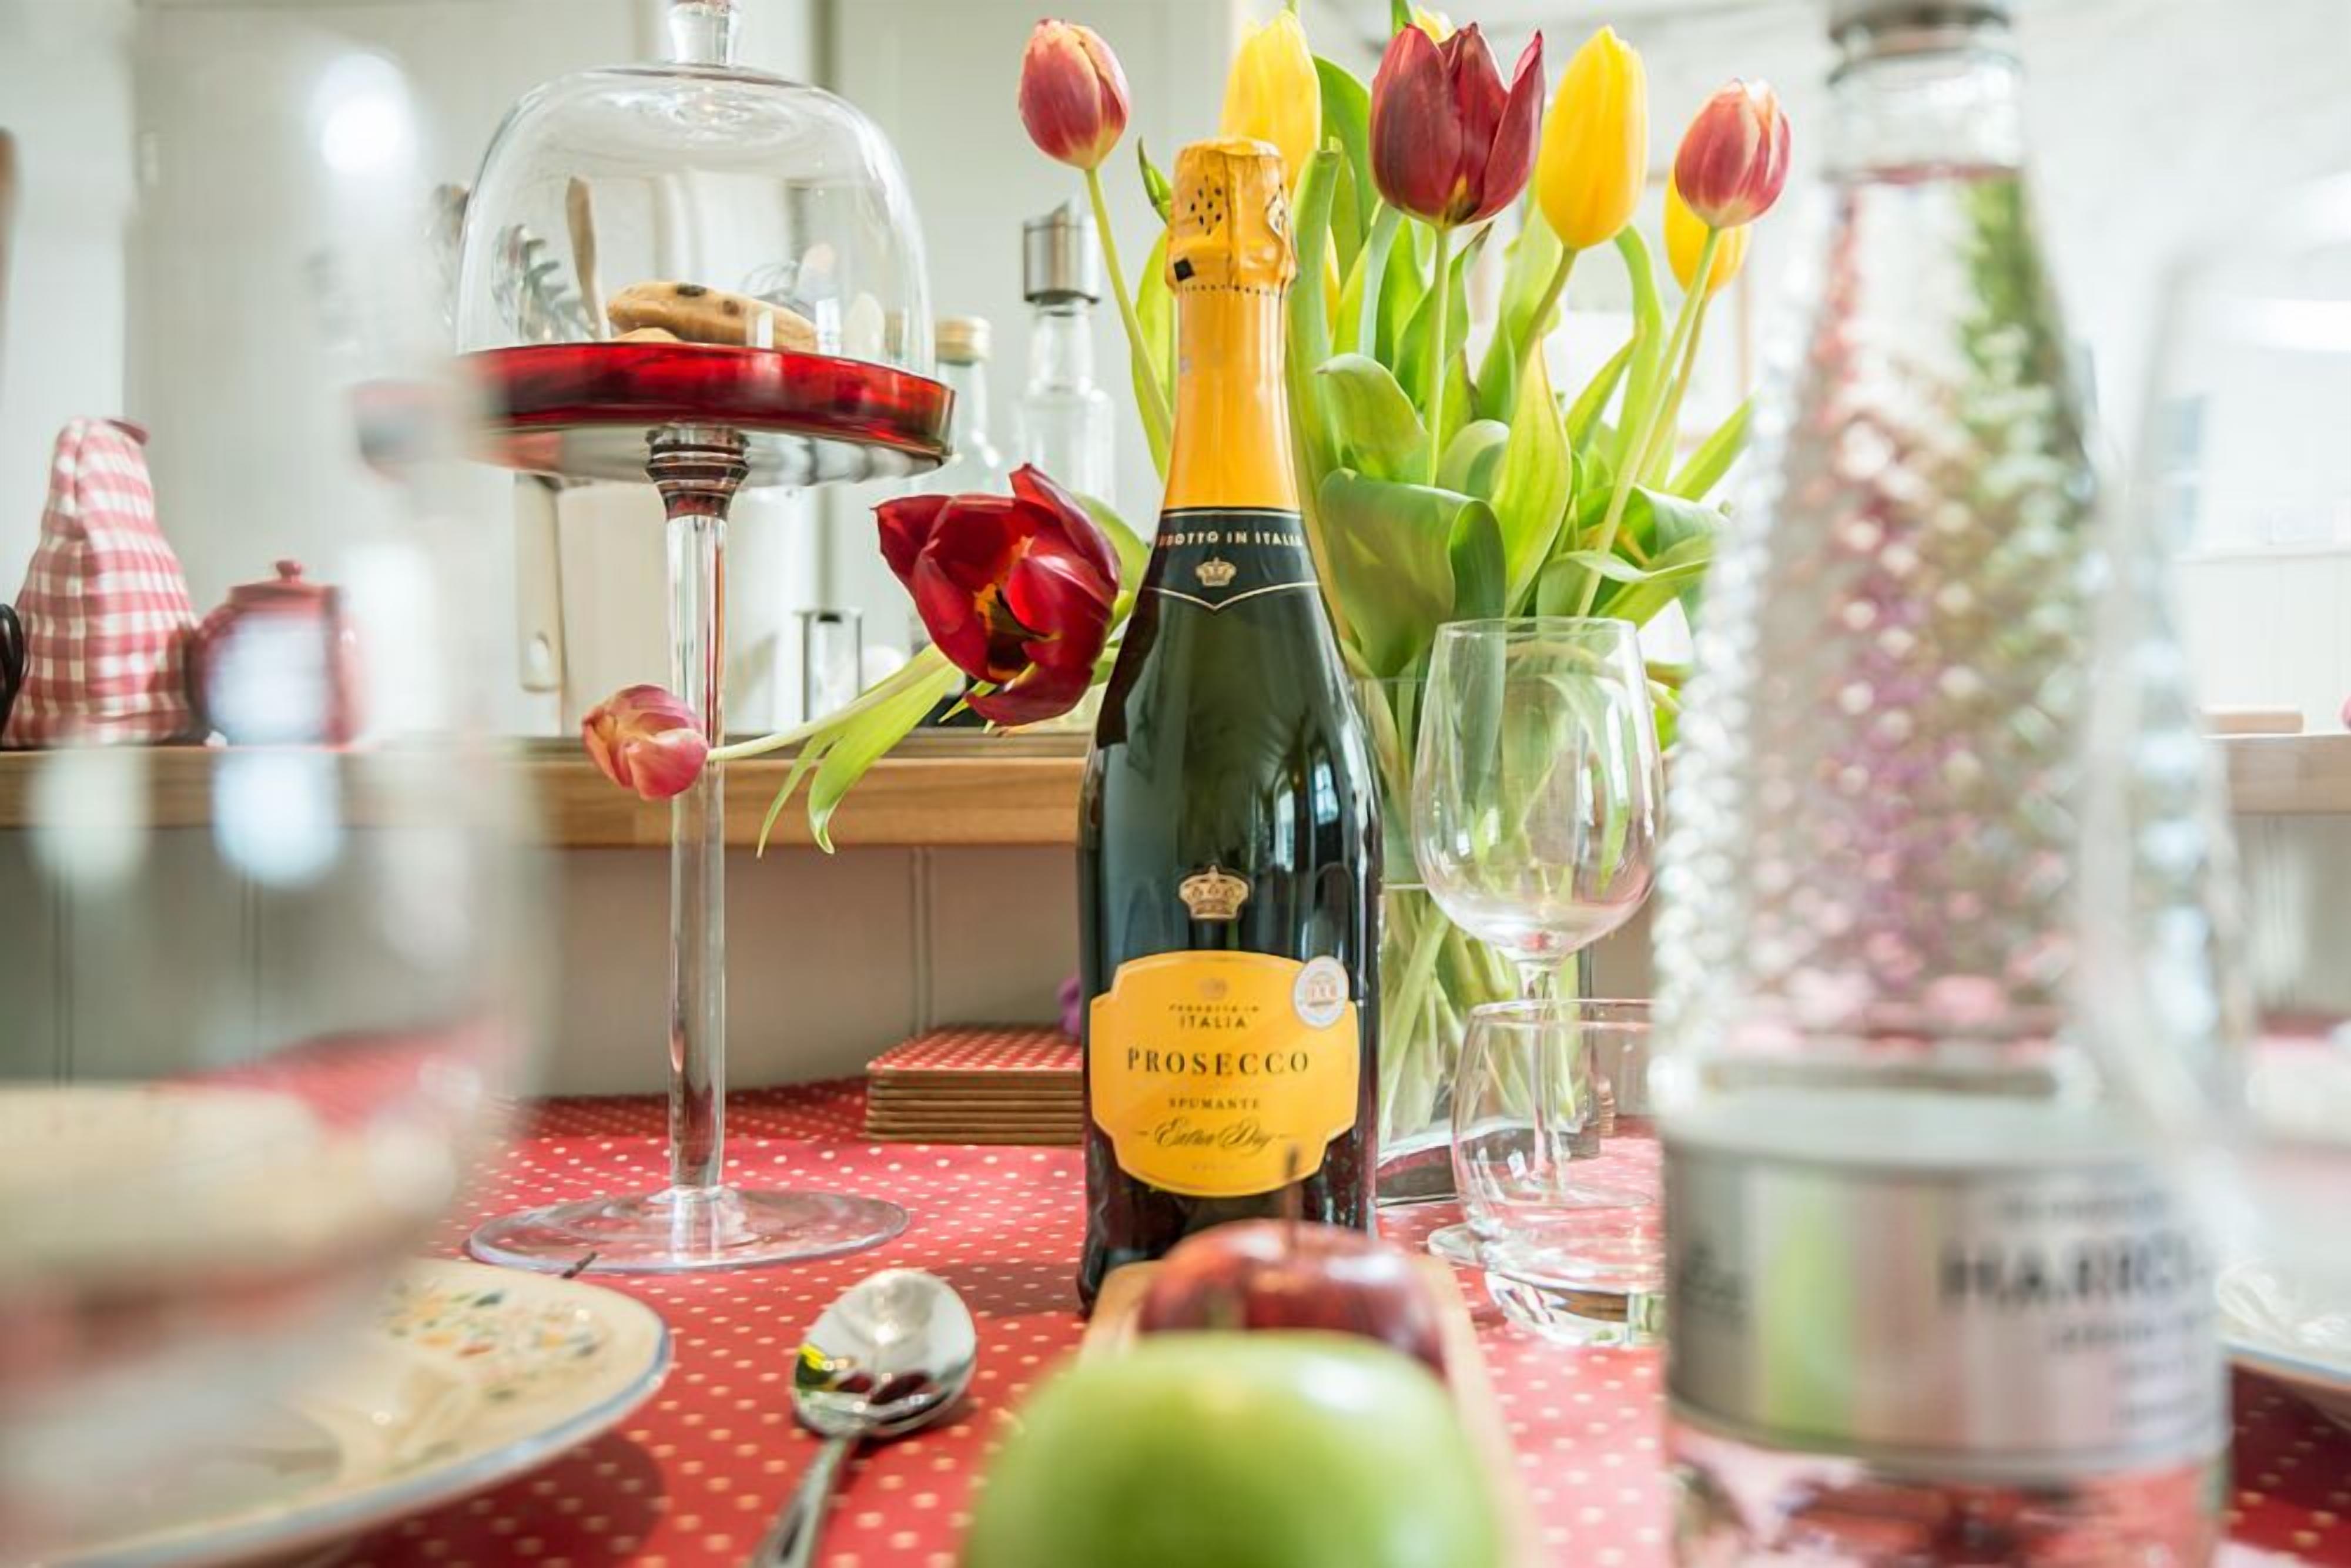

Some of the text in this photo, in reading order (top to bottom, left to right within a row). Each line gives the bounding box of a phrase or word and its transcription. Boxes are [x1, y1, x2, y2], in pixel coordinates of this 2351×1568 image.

[1227, 531, 1247, 544] IN
[1180, 1015, 1246, 1028] ITALIA
[1128, 1047, 1308, 1076] PROSECCO
[1169, 1097, 1259, 1110] SPUMANTE
[1154, 1117, 1274, 1157] Extra Dry
